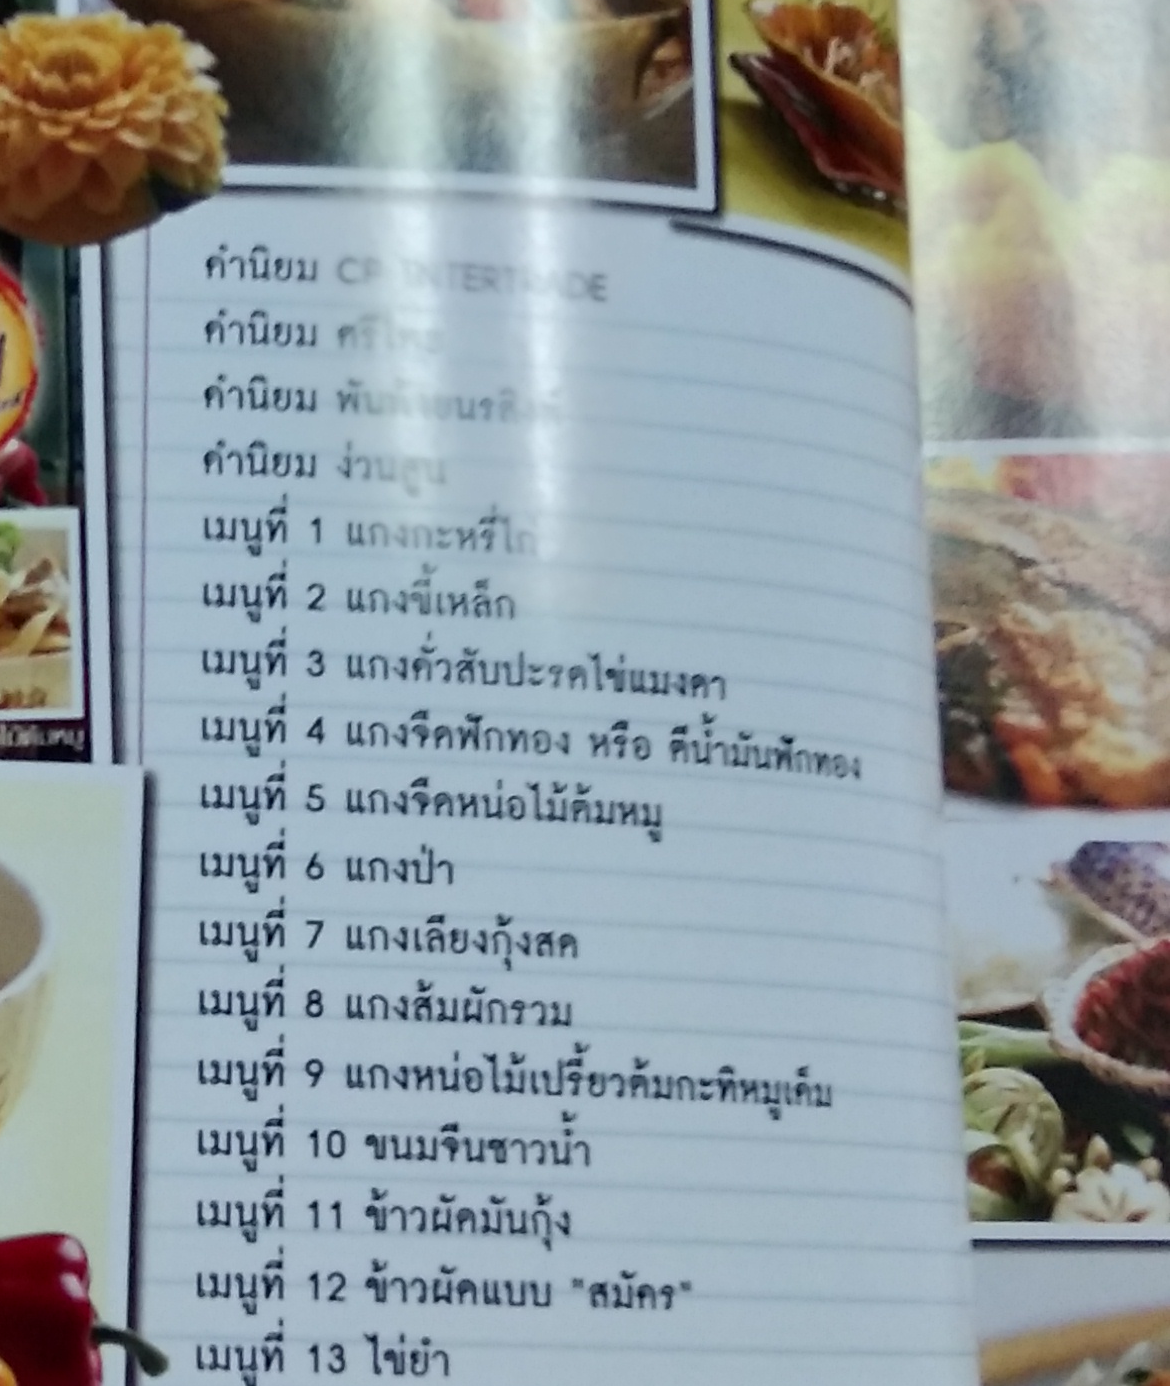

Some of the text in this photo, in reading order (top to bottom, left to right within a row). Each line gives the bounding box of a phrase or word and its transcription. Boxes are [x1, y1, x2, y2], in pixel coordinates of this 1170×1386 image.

[205, 243, 318, 284] คำนิยม
[204, 309, 318, 349] คำนิยม
[204, 374, 317, 414] คำนิยม
[204, 440, 317, 479] คำนิยม
[203, 493, 288, 557] เมนูที่
[310, 516, 322, 545] 1
[202, 559, 516, 624] เมนูที่ 2 แกงขี้เหล็ก
[201, 626, 287, 691] เมนูที่
[306, 648, 326, 678] 3
[201, 692, 287, 758] เมนูที่
[306, 716, 325, 745] 4
[346, 709, 570, 755] แกงจืดฟักทอง
[588, 719, 651, 761] หรือ
[199, 759, 662, 843] เมนูที่ 5 แกงจืดหน่อไม้ต้มหมู
[199, 827, 454, 894] เมนูที่ 6 แกงป่า
[199, 895, 578, 972] เมนูที่ 7 แกงเลียงกุ้งสด
[198, 964, 572, 1032] เมนูที่ 8 แกงส้มผักรวม
[198, 1033, 285, 1102] เมนูที่
[304, 1058, 325, 1088] 9
[197, 1103, 285, 1173] เมนูที่
[308, 1129, 346, 1159] 10
[197, 1174, 571, 1252] เมนูที่ 11 ข้าวผัดมันกุ้ง
[196, 1245, 692, 1316] เมนูที่ 12 ข้าวผัดแบบ "สมัคร"
[308, 1343, 346, 1375] 13
[363, 1333, 450, 1377] ไข่ยำ
